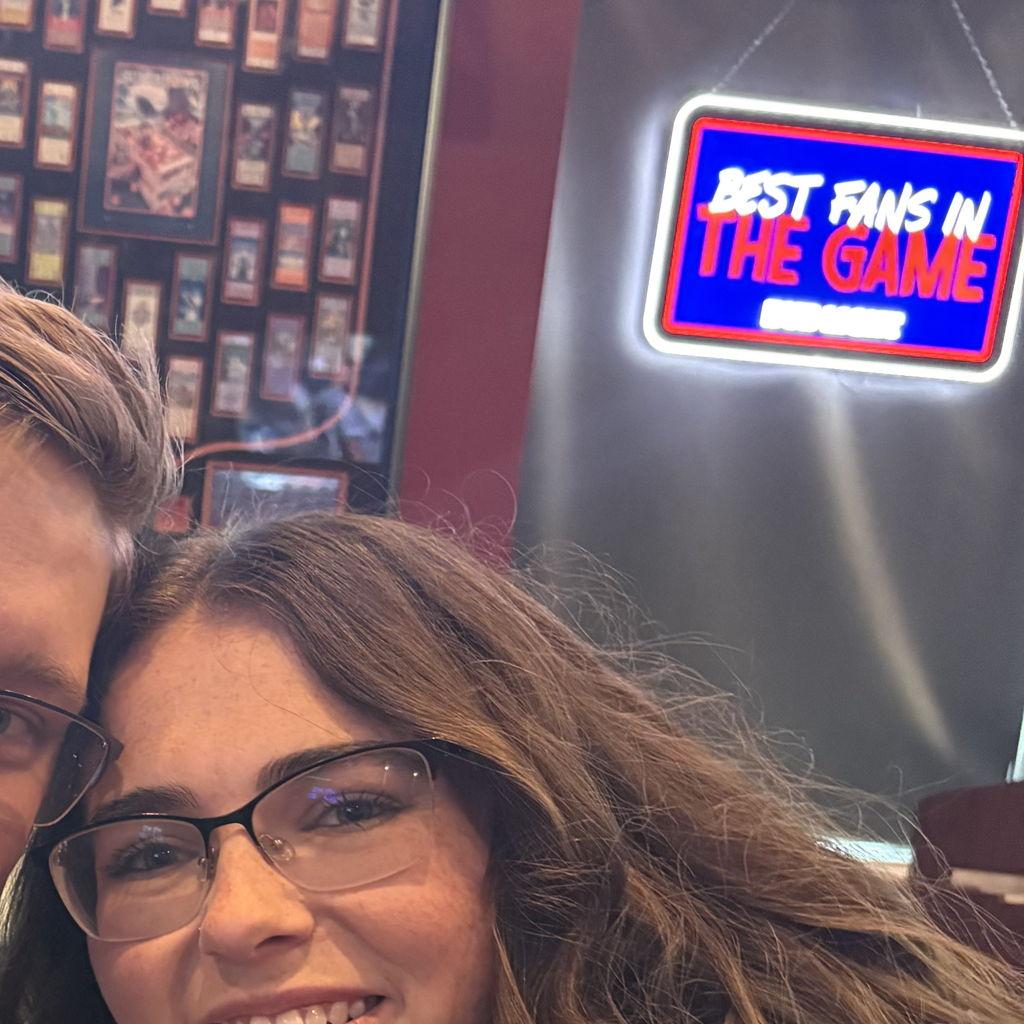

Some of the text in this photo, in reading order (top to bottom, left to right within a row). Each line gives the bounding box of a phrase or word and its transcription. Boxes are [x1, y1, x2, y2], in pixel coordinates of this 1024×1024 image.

[708, 167, 992, 242] BEST FANS IN
[697, 204, 997, 302] THE GAME
